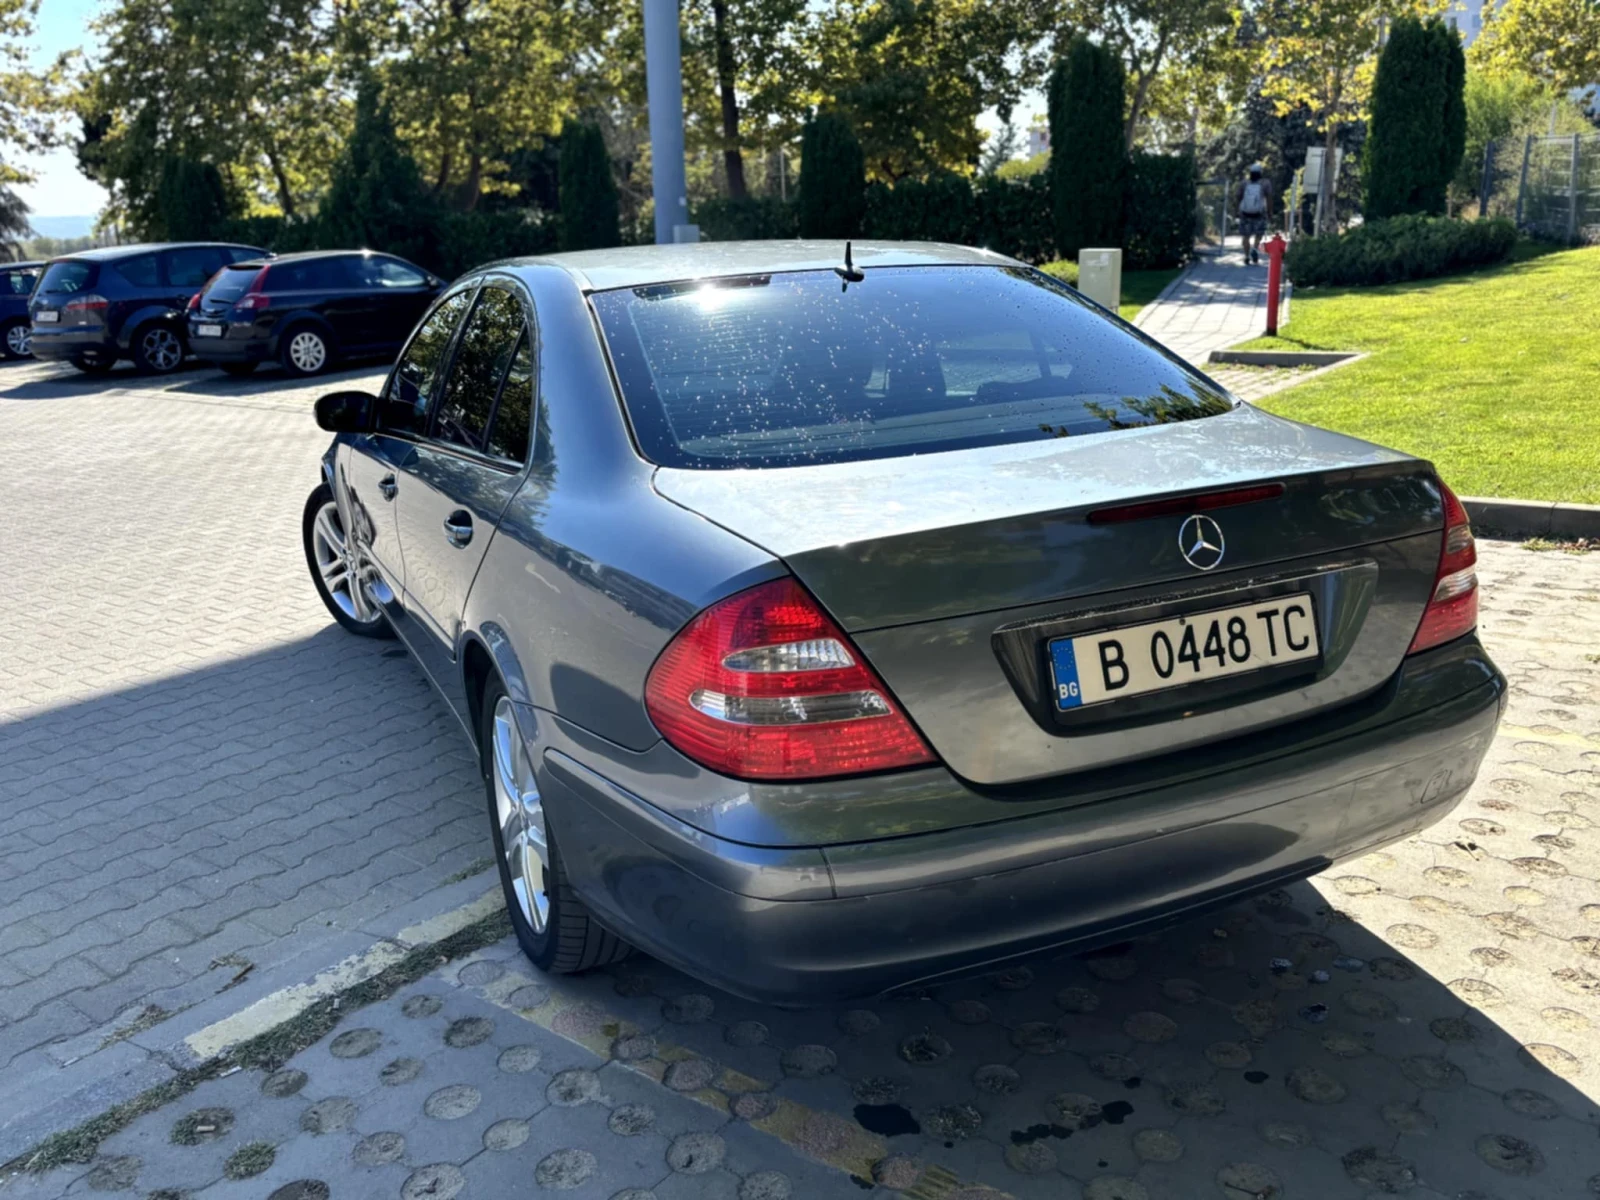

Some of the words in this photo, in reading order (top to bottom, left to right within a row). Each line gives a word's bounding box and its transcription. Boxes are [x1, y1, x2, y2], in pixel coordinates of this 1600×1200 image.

[1098, 639, 1130, 691] B
[1150, 616, 1251, 679] 0448
[1256, 605, 1310, 657] TC
[1059, 681, 1078, 699] BG
